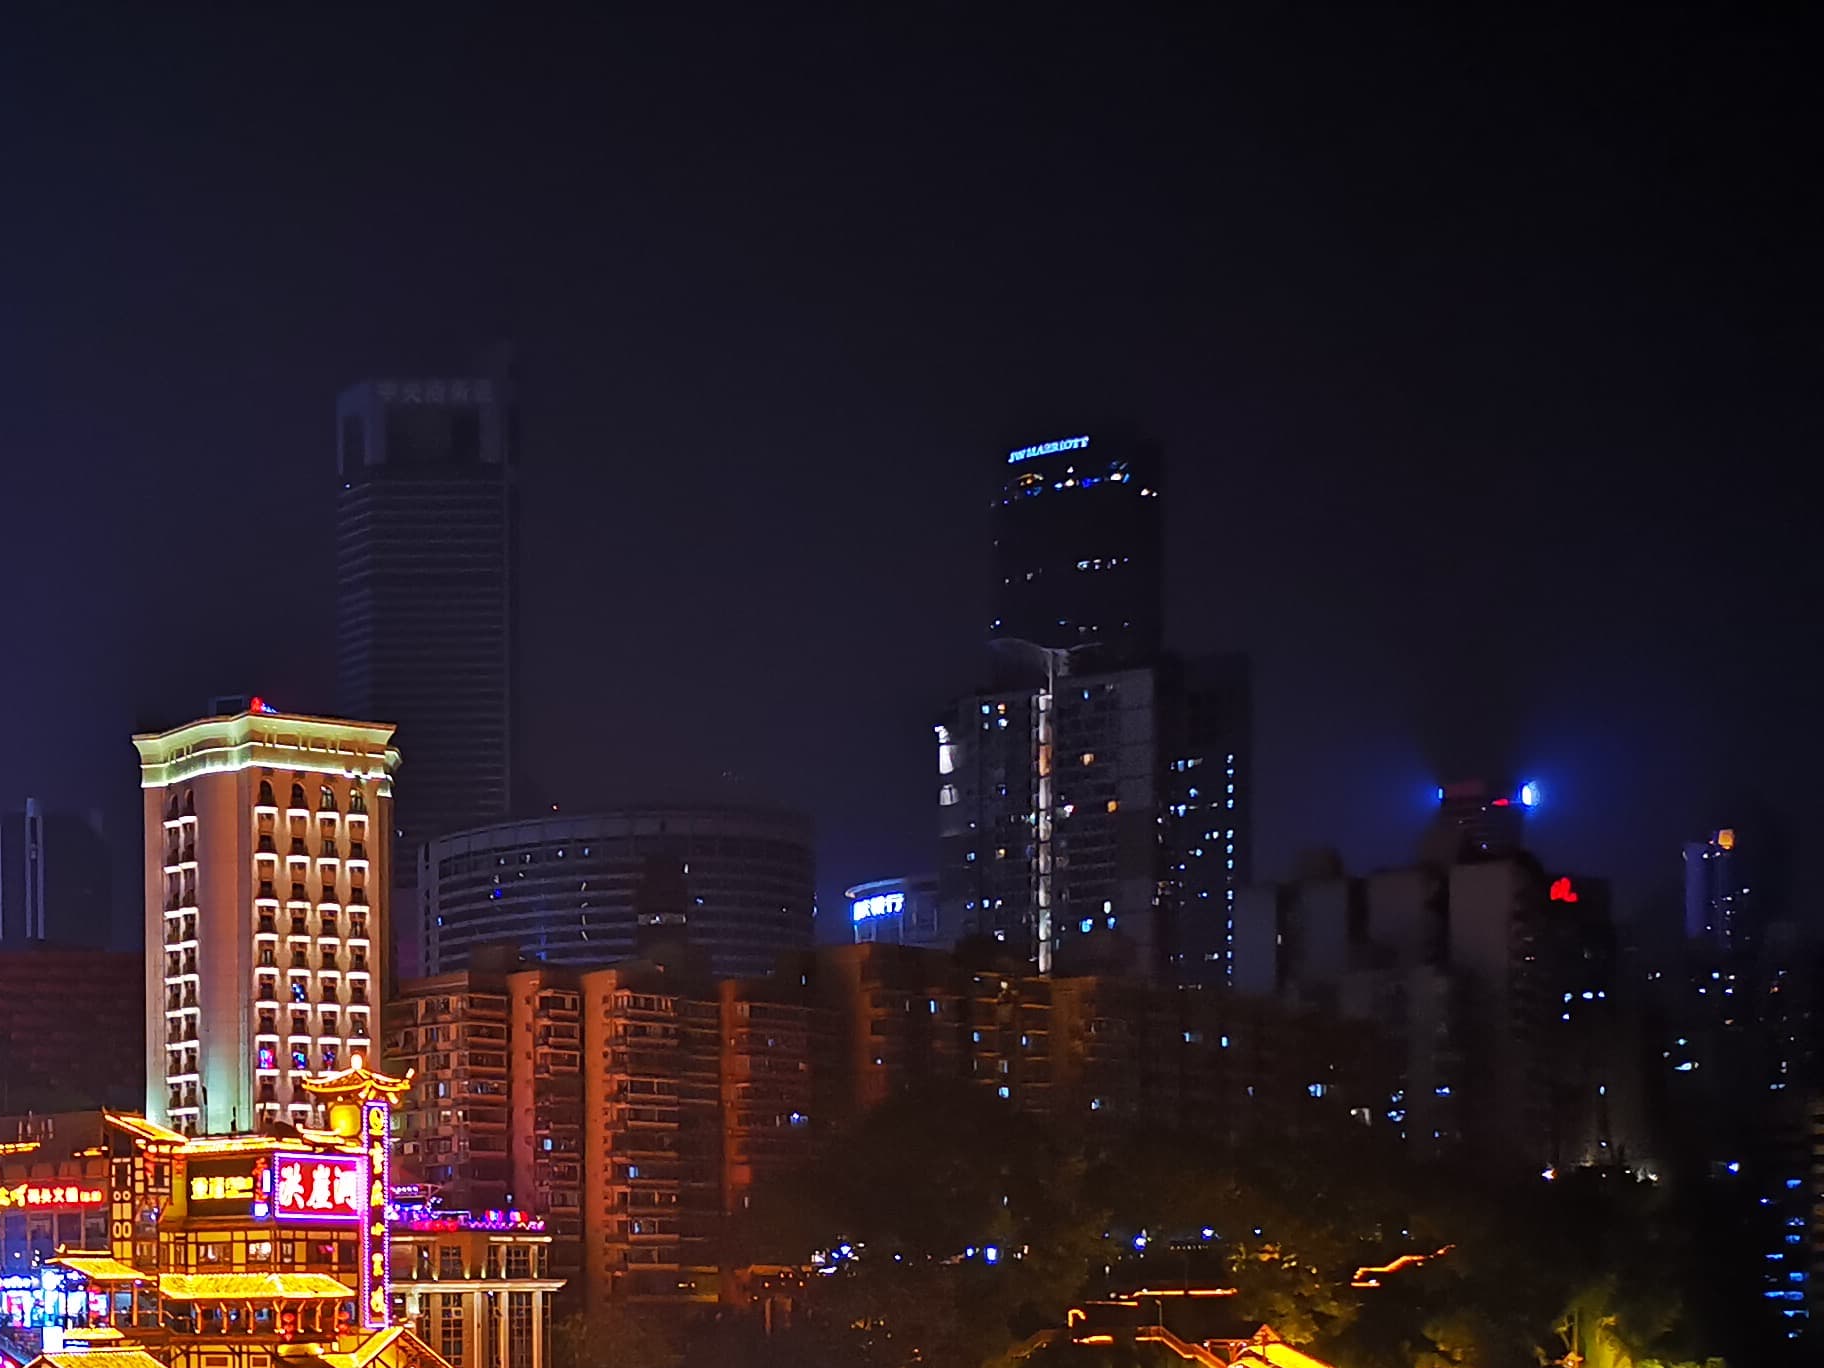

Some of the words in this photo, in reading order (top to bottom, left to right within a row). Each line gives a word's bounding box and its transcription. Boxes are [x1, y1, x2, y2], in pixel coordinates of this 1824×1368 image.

[1026, 436, 1089, 458] MARRIOTT
[278, 1161, 359, 1210] 洪崖洞
